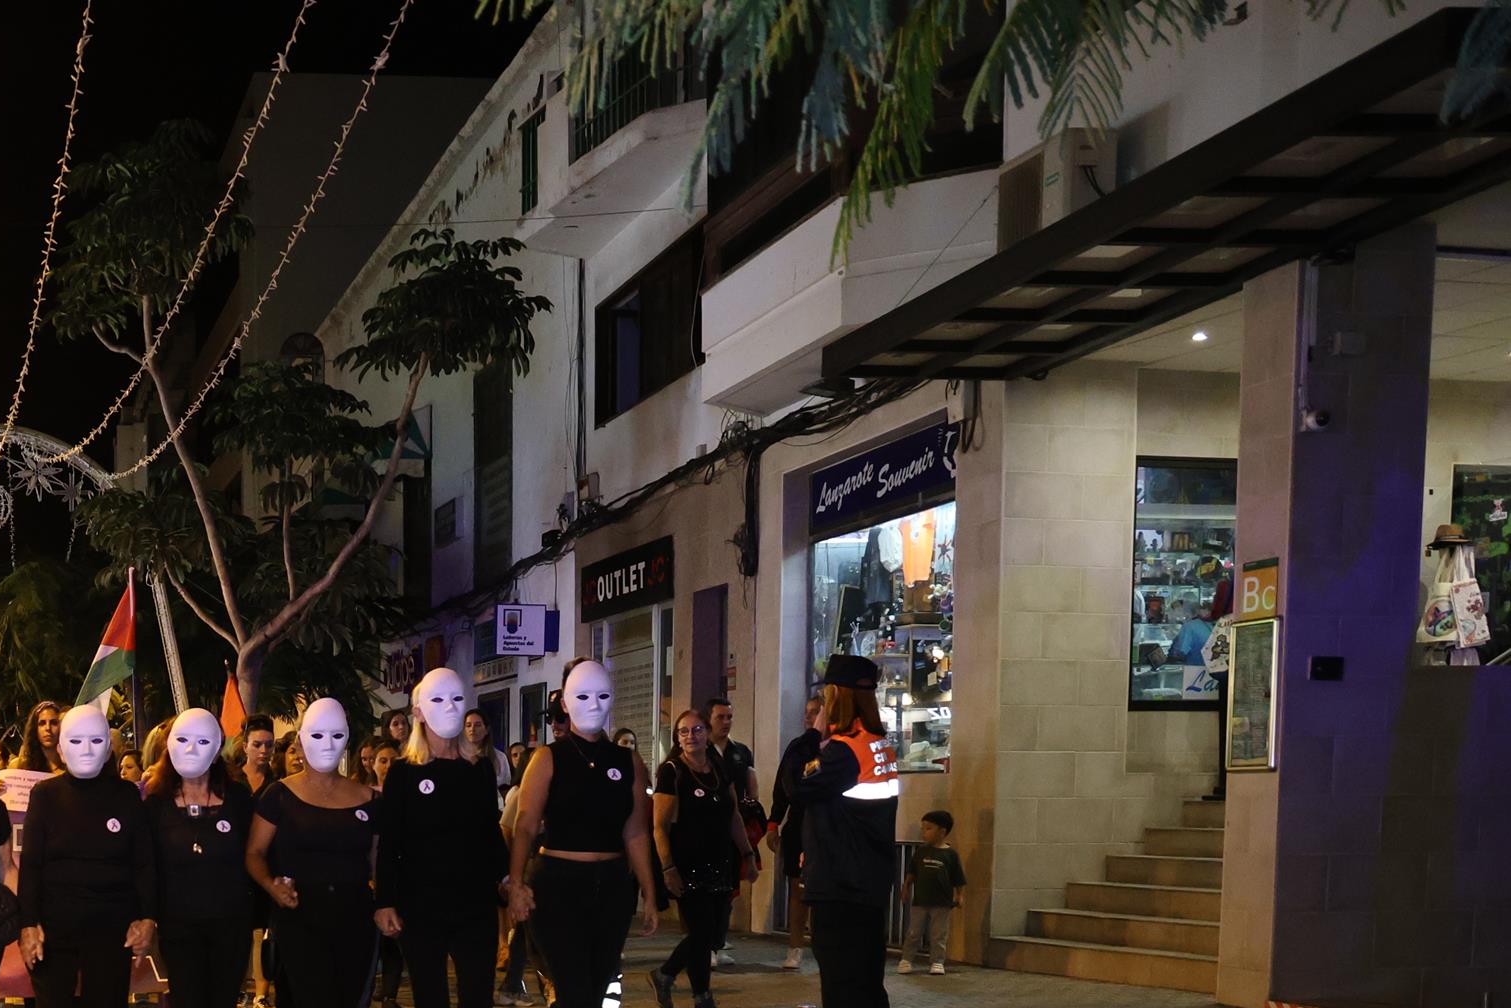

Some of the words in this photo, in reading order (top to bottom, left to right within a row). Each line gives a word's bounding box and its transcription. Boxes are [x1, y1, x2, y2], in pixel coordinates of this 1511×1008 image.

[816, 460, 875, 514] Lanzarote
[875, 446, 936, 499] Souvenir
[596, 560, 646, 603] OUTLET
